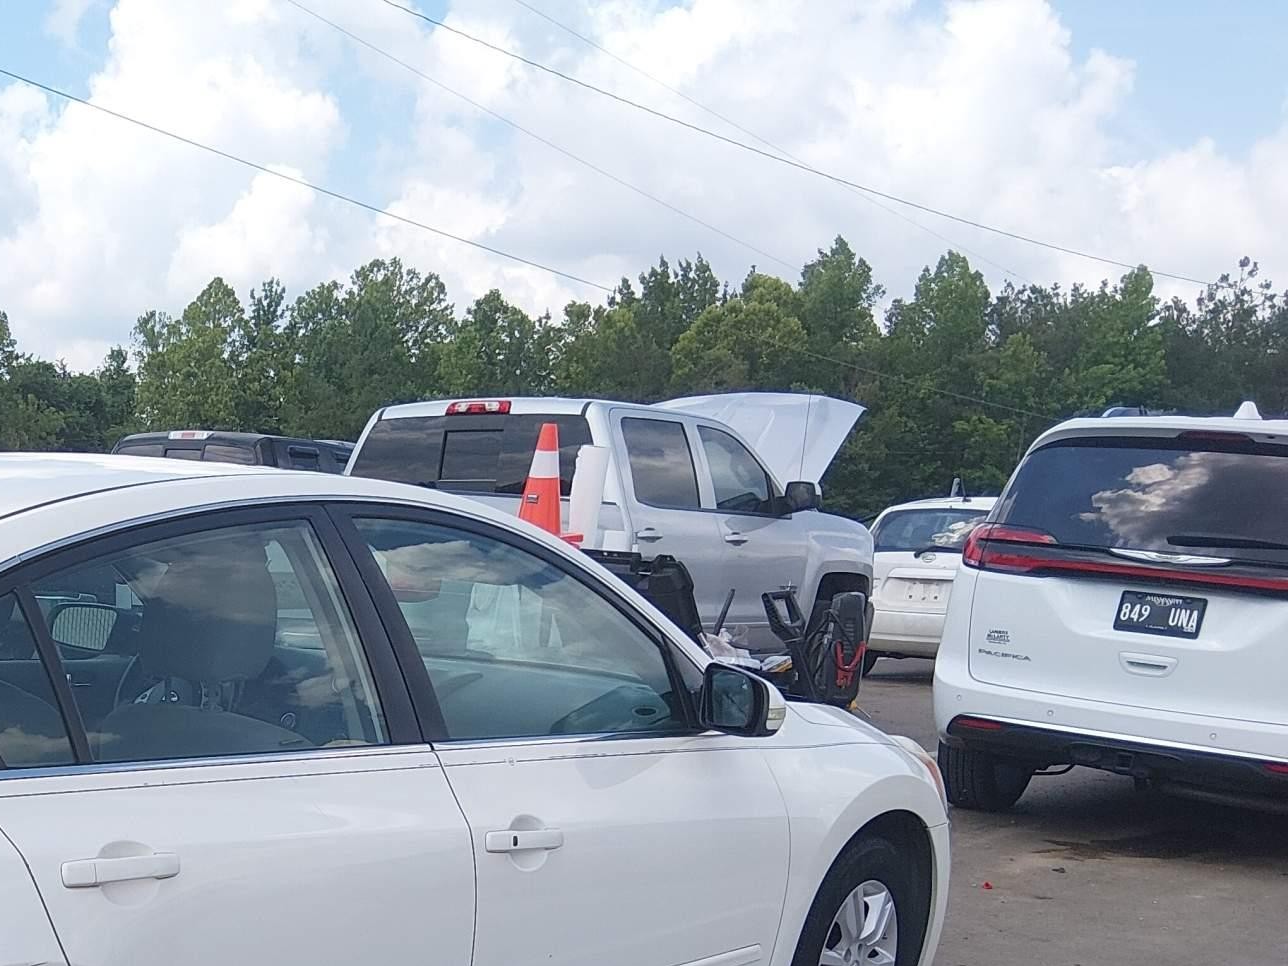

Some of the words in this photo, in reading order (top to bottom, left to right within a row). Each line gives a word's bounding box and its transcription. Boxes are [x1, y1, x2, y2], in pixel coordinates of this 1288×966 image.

[1120, 603, 1151, 622] 849
[1168, 607, 1199, 633] UNA
[978, 648, 1032, 662] PACIFICA
